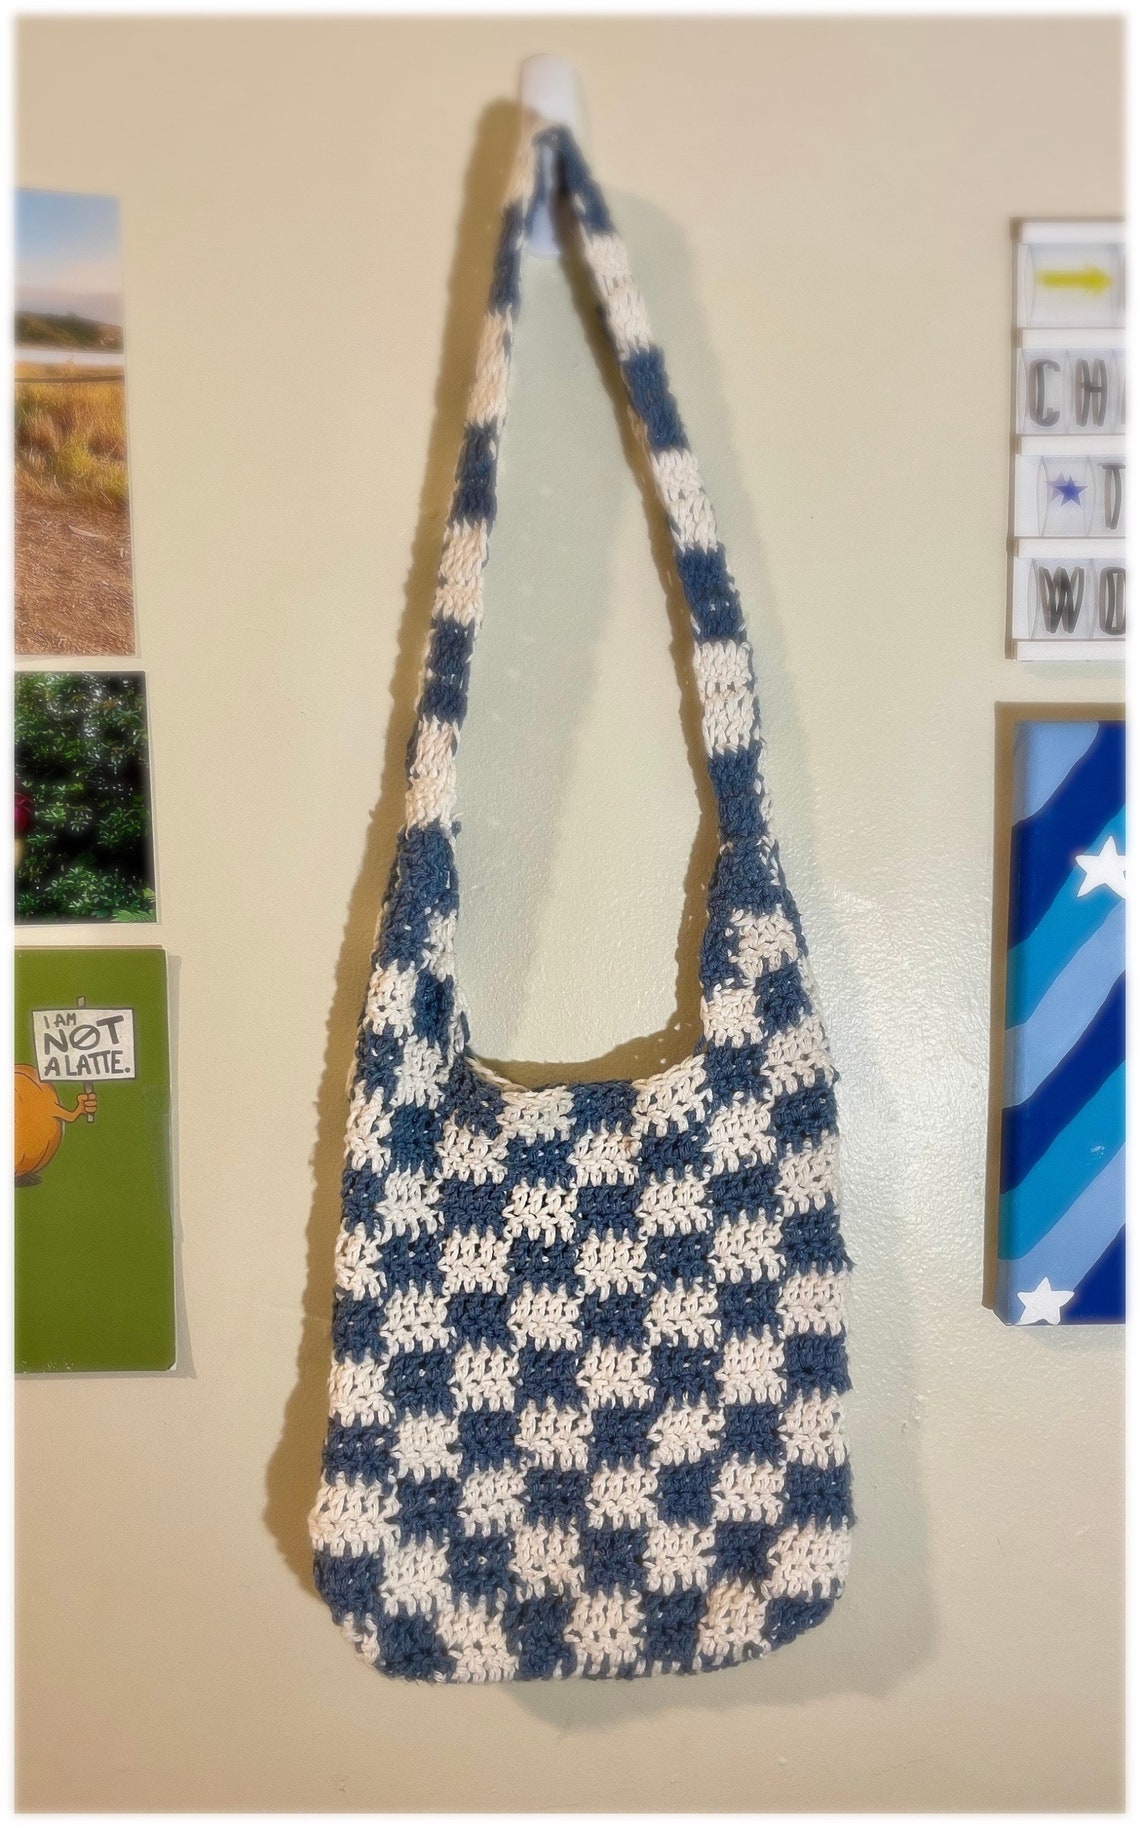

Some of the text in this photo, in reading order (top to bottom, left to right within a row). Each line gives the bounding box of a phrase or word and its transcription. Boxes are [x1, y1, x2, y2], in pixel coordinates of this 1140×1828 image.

[1028, 358, 1126, 427] CH
[44, 1012, 77, 1029] I AM
[44, 1015, 124, 1055] NOT
[44, 1050, 131, 1077] A LATTE.
